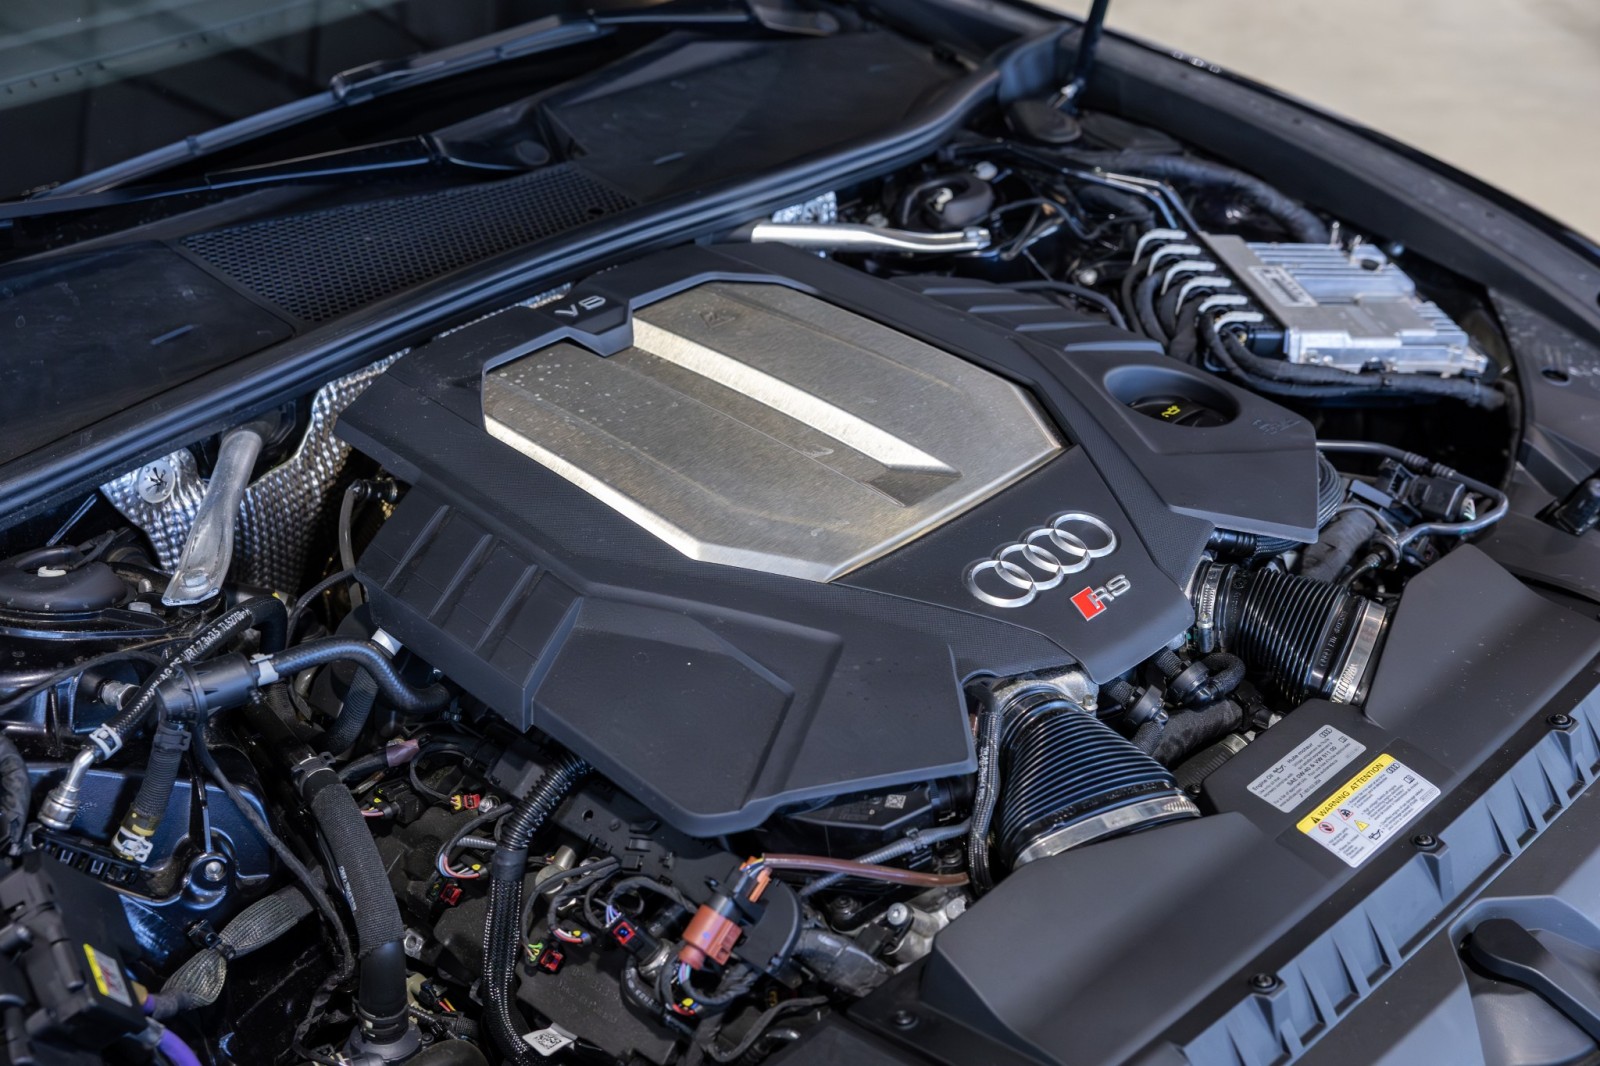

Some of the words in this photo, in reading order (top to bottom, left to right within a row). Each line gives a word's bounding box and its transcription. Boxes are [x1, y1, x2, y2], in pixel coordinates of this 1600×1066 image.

[554, 295, 606, 317] V8
[1087, 574, 1131, 610] RS
[1286, 754, 1299, 763] Huile
[1297, 742, 1314, 755] moteur
[1251, 778, 1268, 791] Engine
[1286, 777, 1298, 786] SAE
[1316, 790, 1351, 818] WARNING
[1349, 762, 1385, 791] ATTENTION
